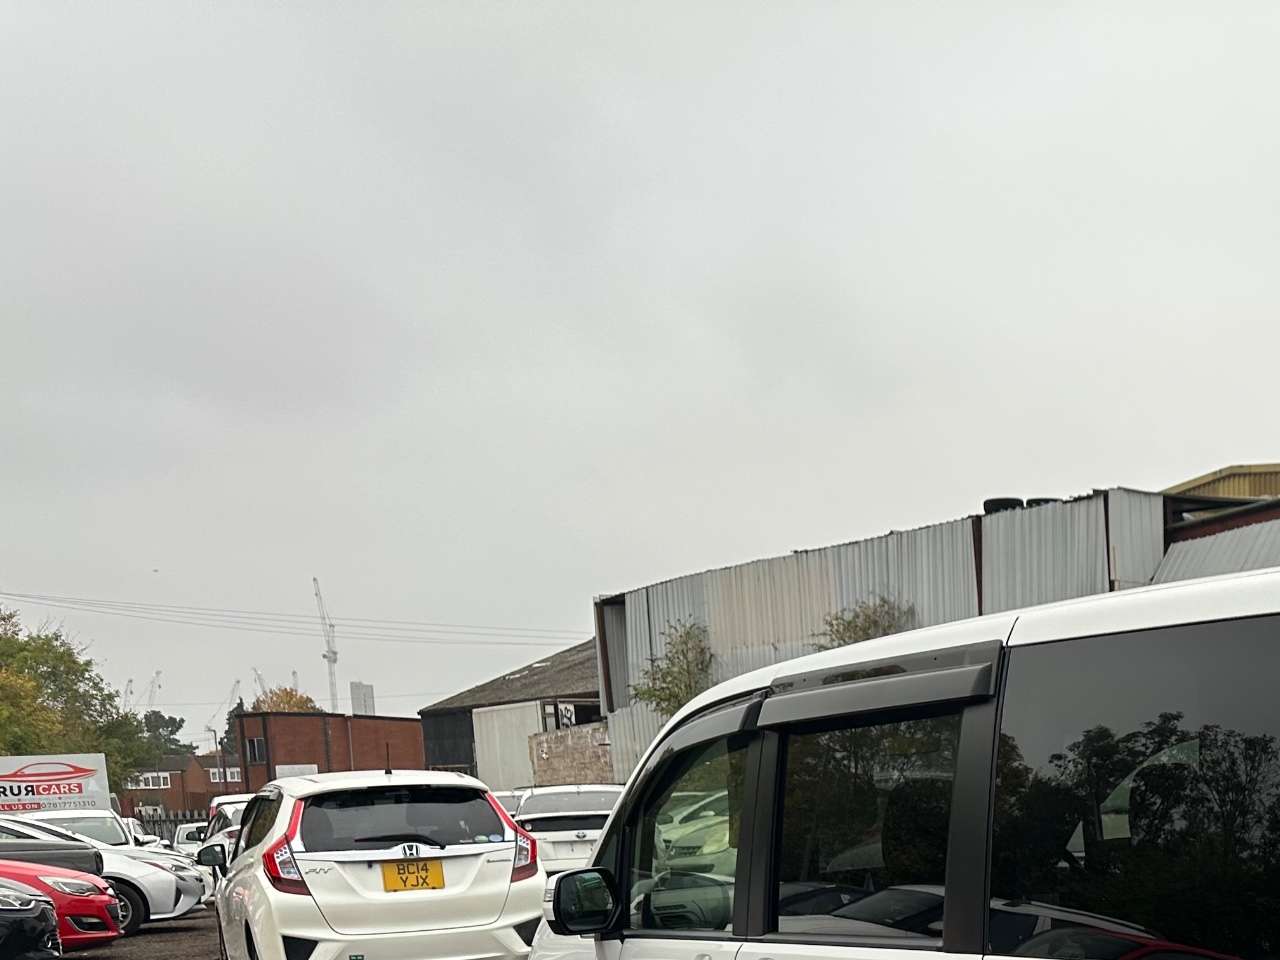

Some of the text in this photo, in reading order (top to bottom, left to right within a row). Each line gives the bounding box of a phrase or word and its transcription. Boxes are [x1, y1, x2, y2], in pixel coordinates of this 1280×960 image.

[39, 784, 79, 794] CARS
[397, 863, 429, 875] BC14
[400, 875, 430, 888] YJX
